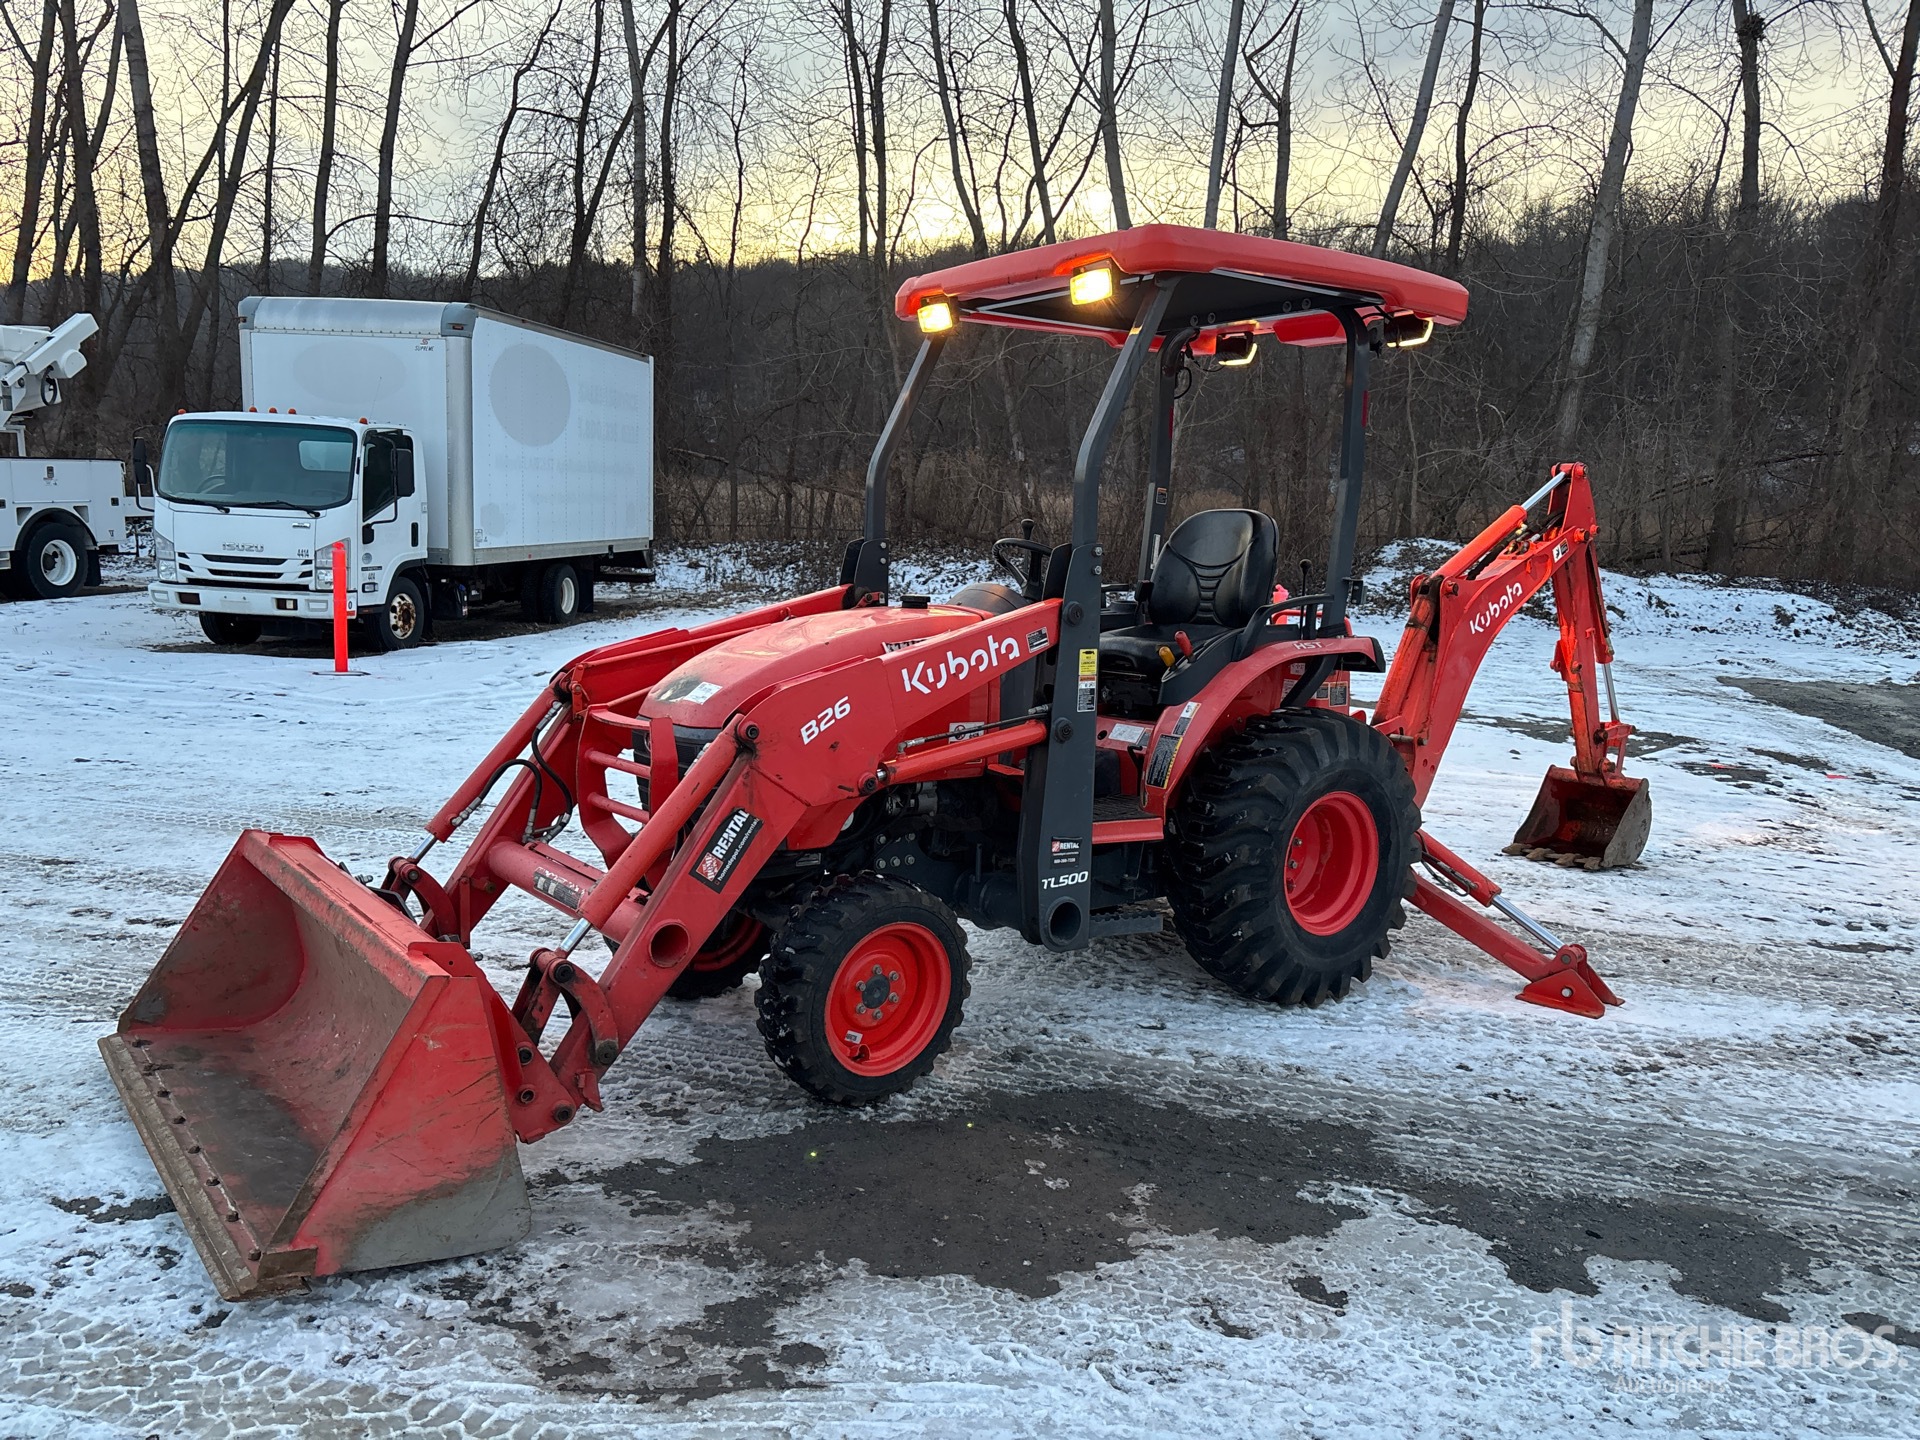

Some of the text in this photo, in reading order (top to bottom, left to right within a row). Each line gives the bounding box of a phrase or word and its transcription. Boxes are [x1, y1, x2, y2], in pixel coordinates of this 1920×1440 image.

[222, 542, 264, 552] ISUZU
[296, 549, 310, 558] 4414
[1469, 582, 1523, 635] Kubota
[1293, 641, 1323, 650] HST
[901, 634, 1020, 695] Kubota
[800, 695, 851, 746] B26
[711, 810, 750, 860] RENTAL
[1060, 842, 1080, 850] RENTAL
[1041, 871, 1089, 890] TL500
